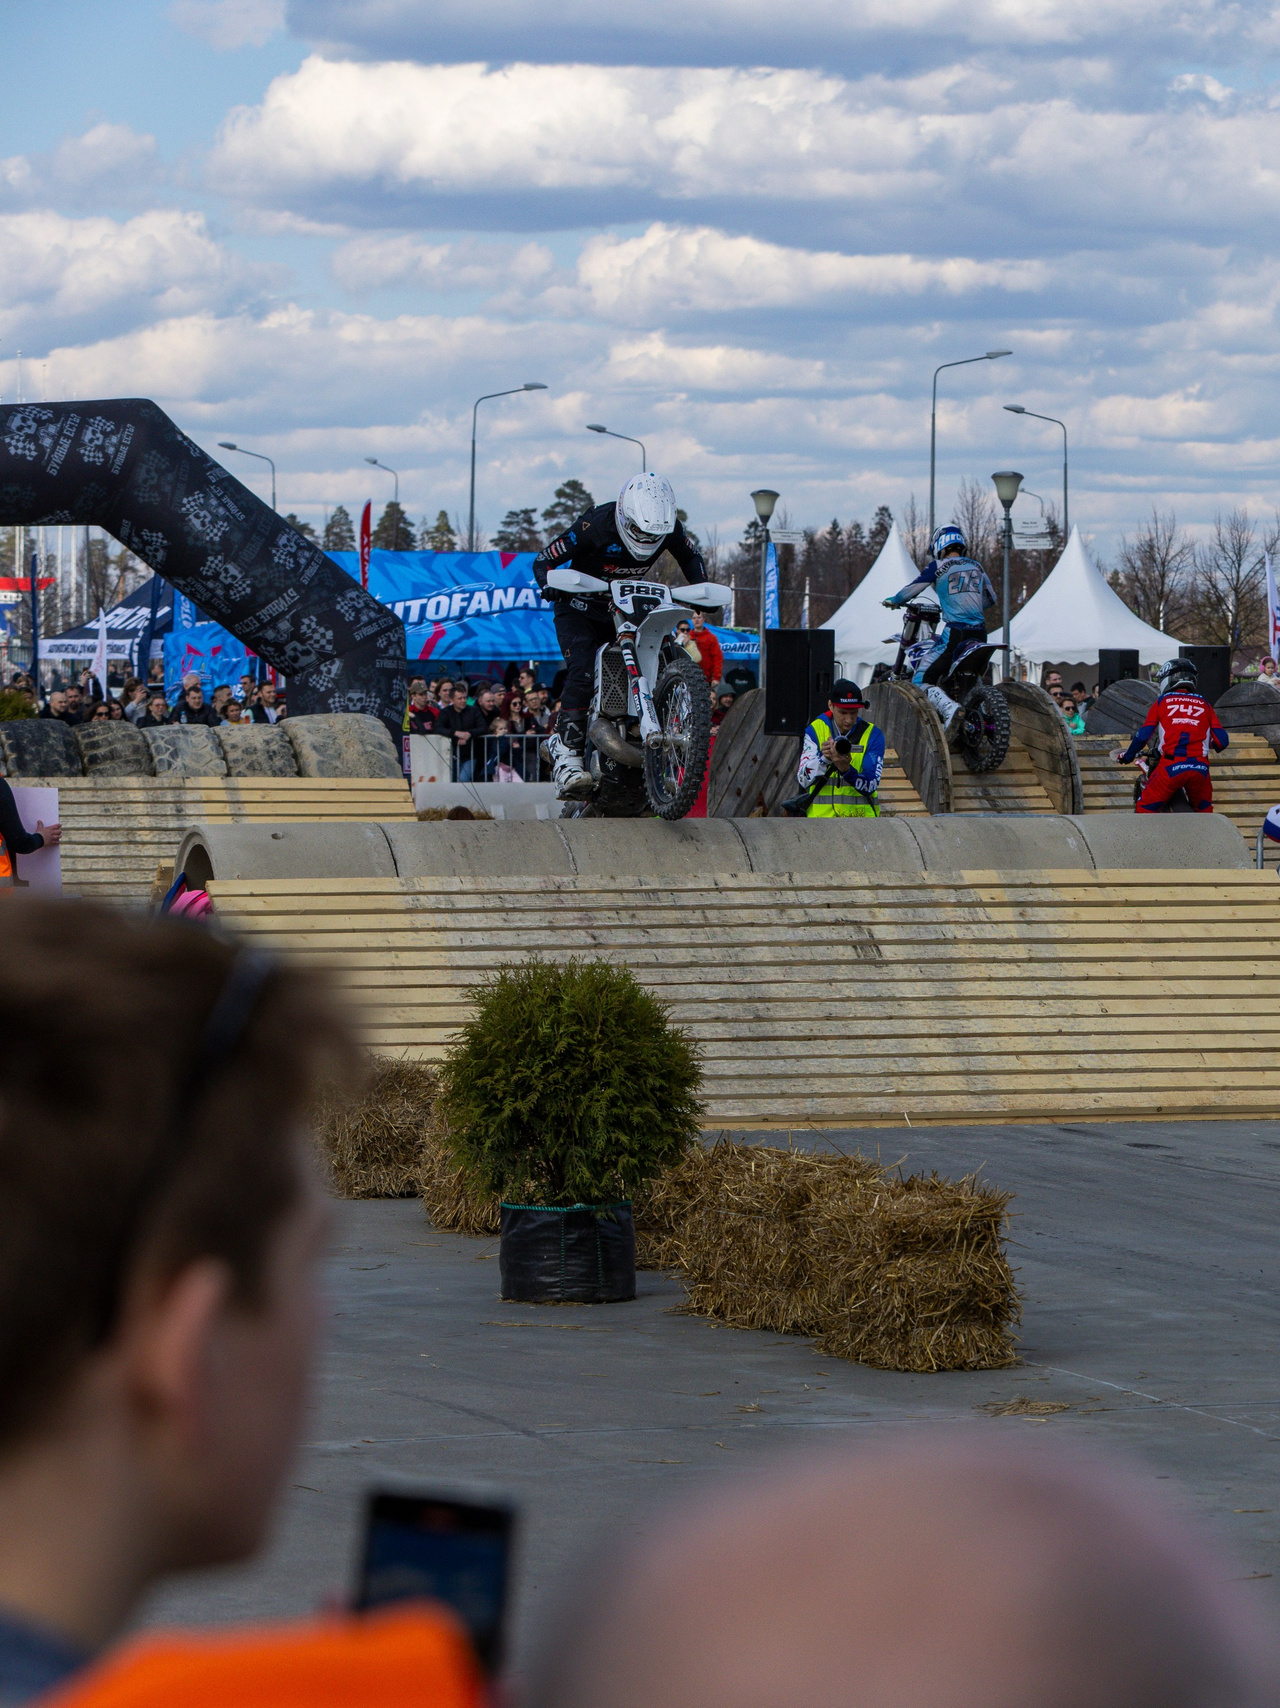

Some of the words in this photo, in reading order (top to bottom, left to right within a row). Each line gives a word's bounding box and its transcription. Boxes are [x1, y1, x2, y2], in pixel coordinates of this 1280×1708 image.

[46, 436, 72, 476] БУЙНЫЕ
[63, 413, 81, 438] ЕСТЬ?
[111, 444, 128, 475] БУЙНЫЕ
[122, 423, 135, 445] ЕСТЬ?
[645, 523, 673, 532] LEATT
[948, 569, 981, 596] 272
[256, 587, 300, 623] БУЙНЫЕ
[386, 587, 551, 623] UTOFANAT
[1165, 697, 1204, 705] SITNIKOV
[1166, 704, 1205, 717] 747
